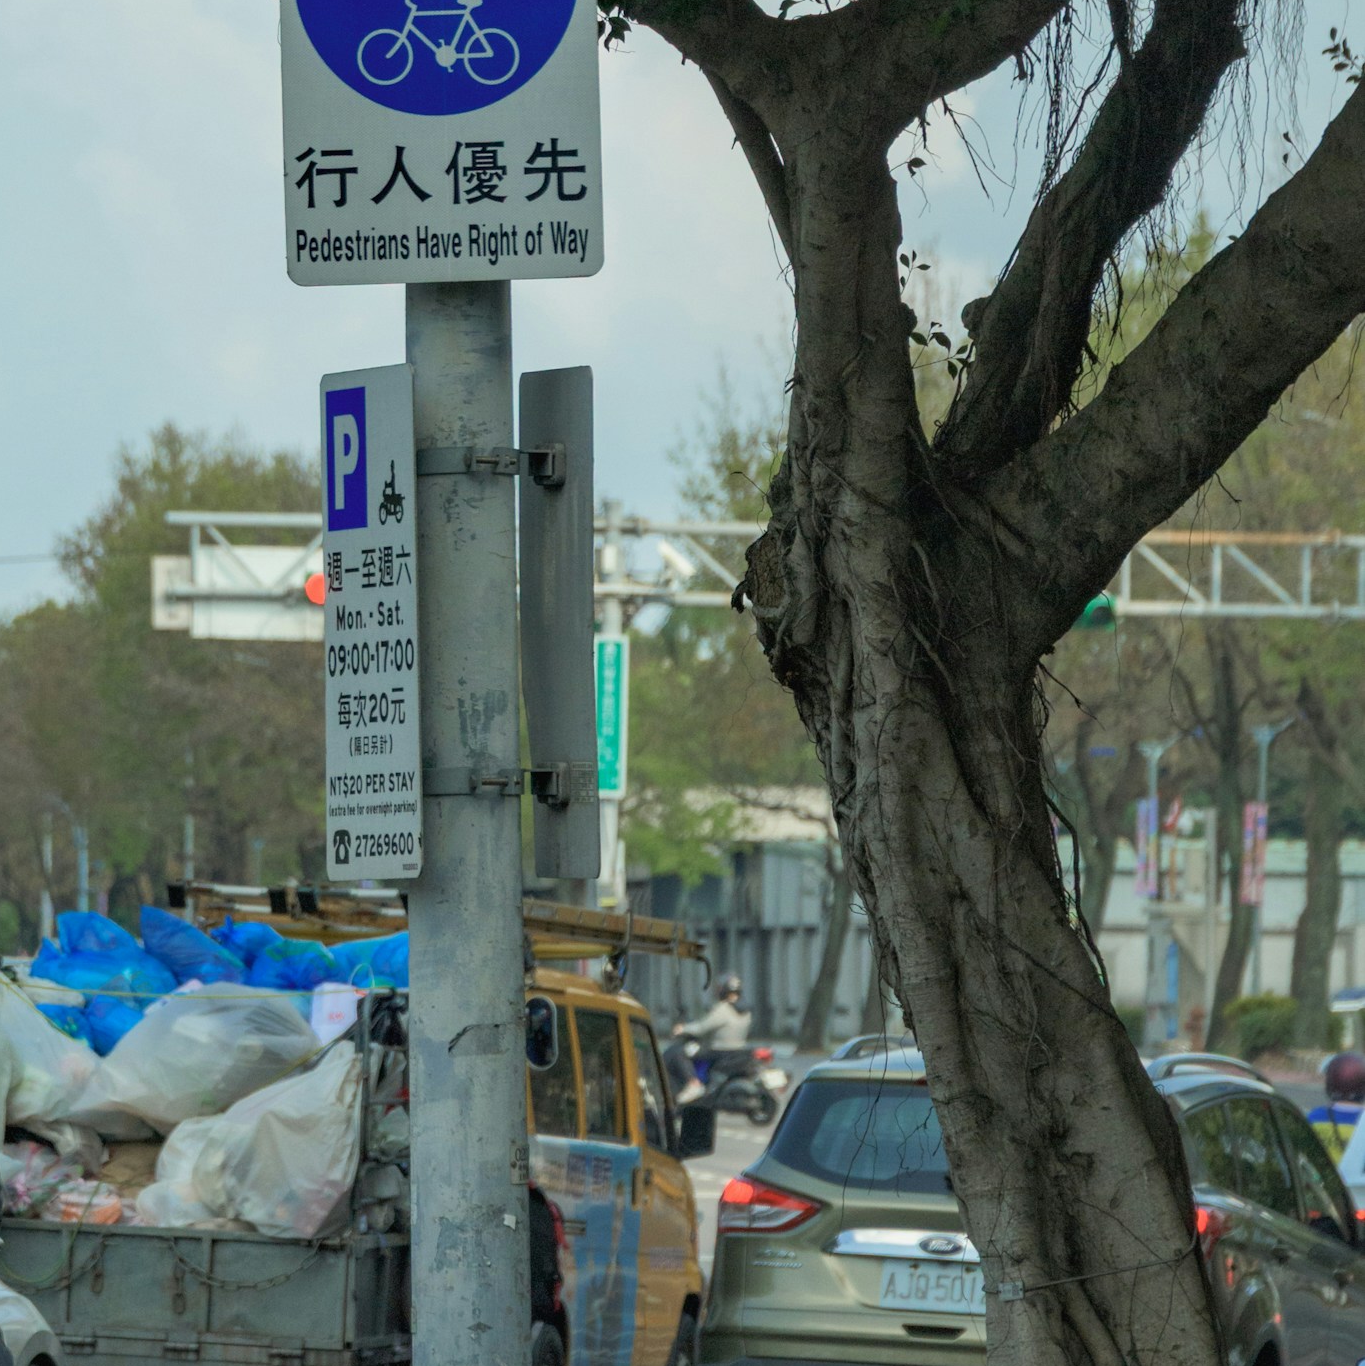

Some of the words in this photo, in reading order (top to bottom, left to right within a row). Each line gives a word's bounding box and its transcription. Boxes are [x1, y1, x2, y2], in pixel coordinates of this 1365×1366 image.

[295, 137, 588, 209] 行人優先
[295, 227, 410, 263] Pedestrians
[416, 225, 463, 260] Have
[468, 222, 519, 266] Right
[524, 221, 544, 255] of
[550, 220, 589, 263] Way
[327, 544, 412, 593] 週一至週六
[328, 638, 415, 678] 09:00-17:00
[337, 687, 406, 730] 每次20元
[349, 734, 394, 757] (隔日另計)
[329, 773, 363, 799] NT$20
[365, 773, 386, 795] PER
[388, 771, 416, 793] STAY
[329, 803, 347, 817] (extra
[347, 803, 356, 816] fee
[356, 803, 365, 815] for
[366, 801, 393, 817] overnight
[393, 799, 418, 817] parking)
[355, 831, 414, 858] 27269600
